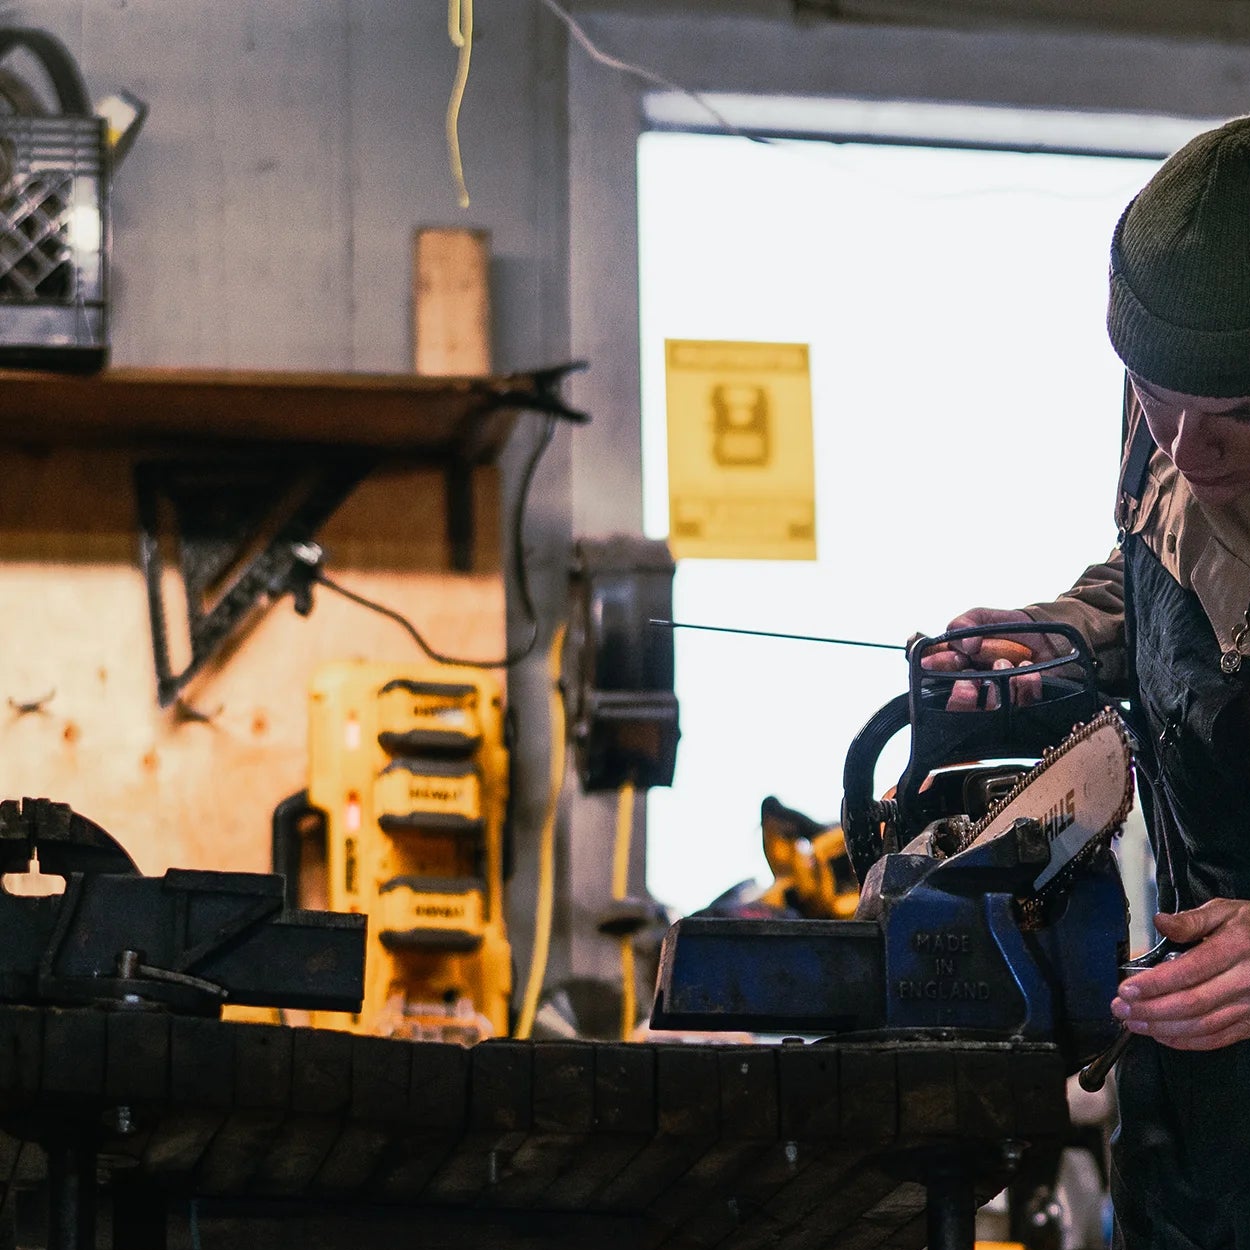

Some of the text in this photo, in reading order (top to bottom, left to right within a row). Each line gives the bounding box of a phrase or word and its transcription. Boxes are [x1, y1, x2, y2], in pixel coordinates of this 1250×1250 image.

[916, 933, 969, 952] MADE
[935, 958, 953, 976] IN
[899, 980, 990, 1000] ENGLAND
